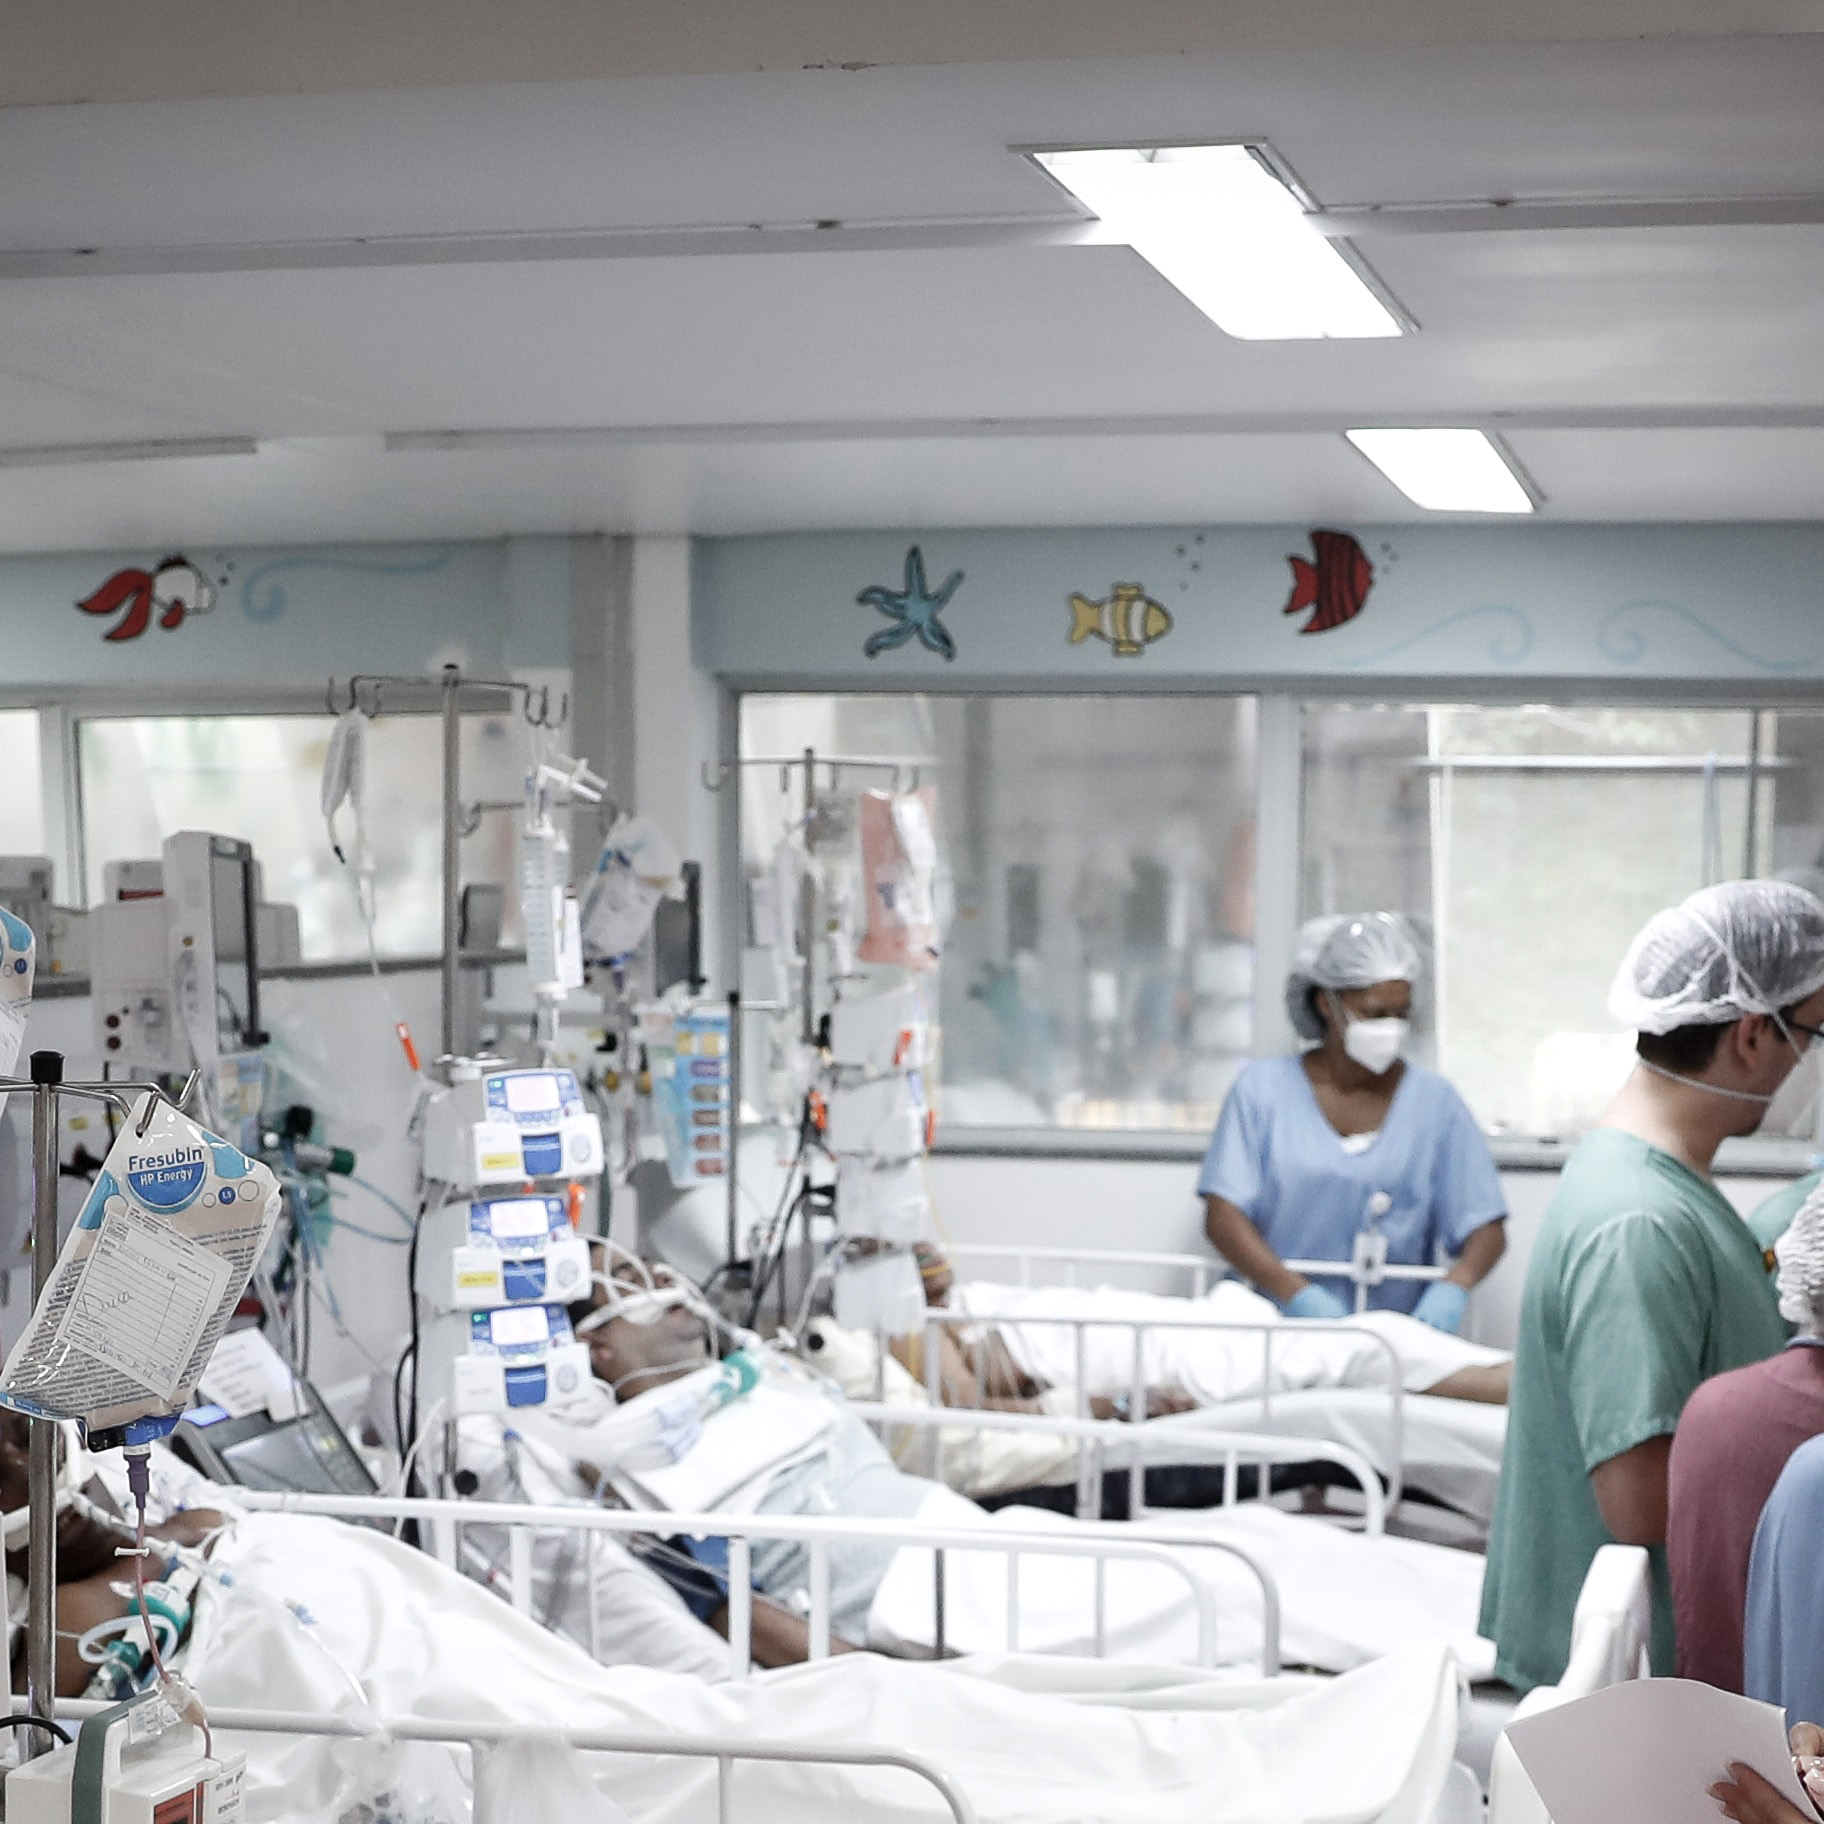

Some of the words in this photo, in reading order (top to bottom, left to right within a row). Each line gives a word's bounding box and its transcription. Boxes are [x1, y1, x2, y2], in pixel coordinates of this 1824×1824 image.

[129, 1147, 203, 1171] Fresubin
[140, 1171, 154, 1186] HP
[157, 1169, 193, 1184] Energy
